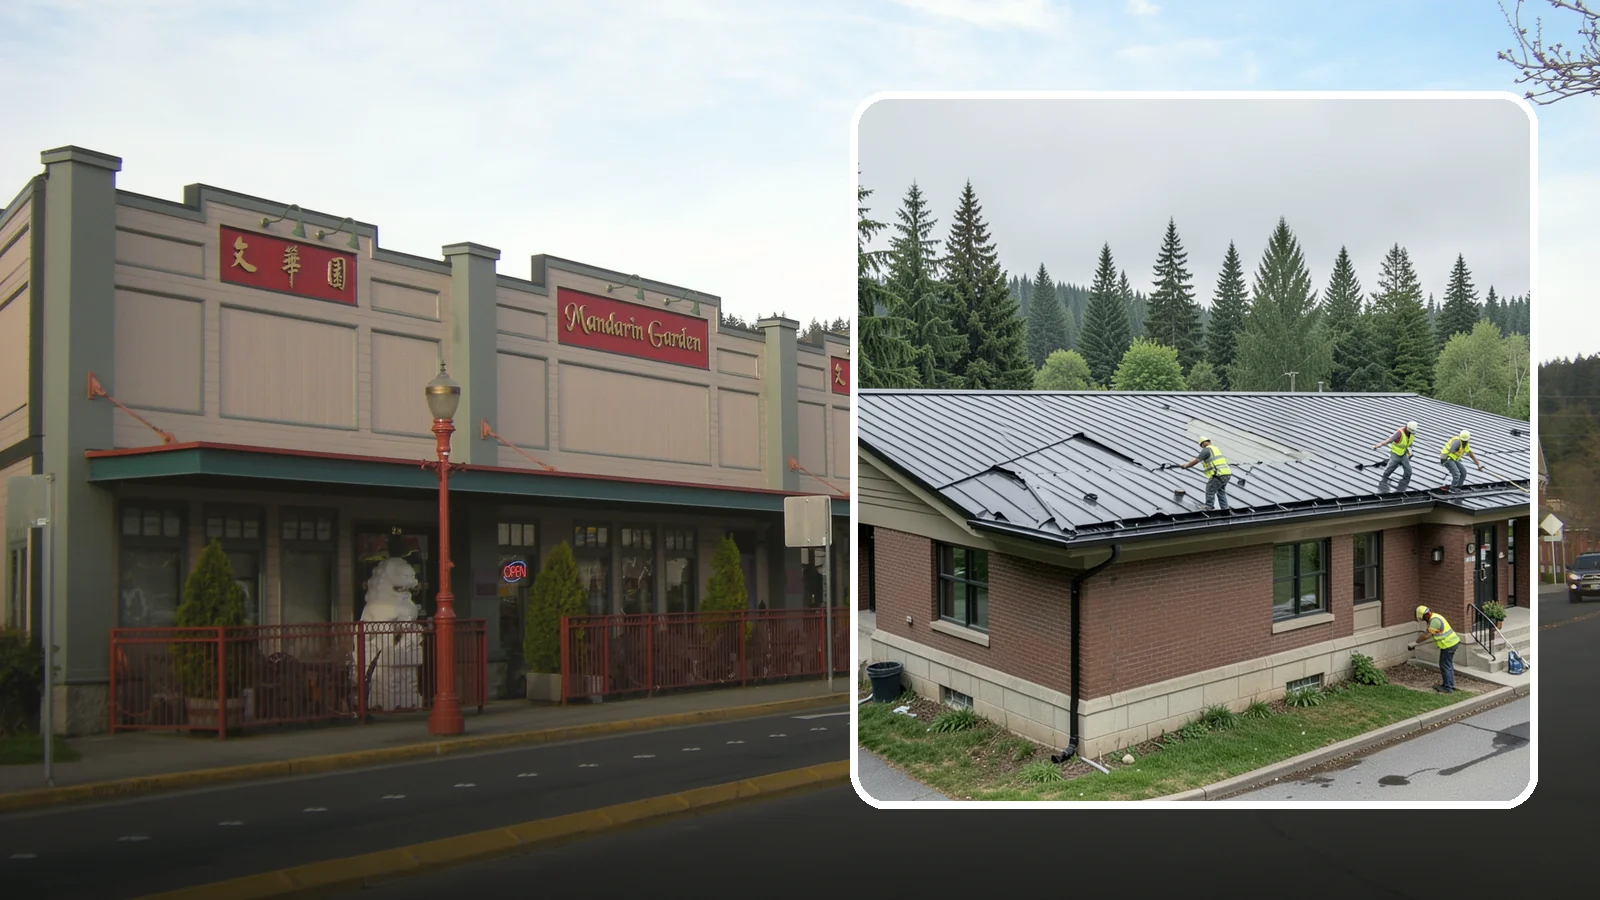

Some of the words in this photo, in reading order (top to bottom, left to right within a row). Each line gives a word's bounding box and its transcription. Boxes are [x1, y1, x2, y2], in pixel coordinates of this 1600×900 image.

[231, 236, 346, 291] 文華園
[564, 302, 644, 341] Mandarin
[648, 320, 701, 352] Garden
[503, 565, 527, 578] OPEN
